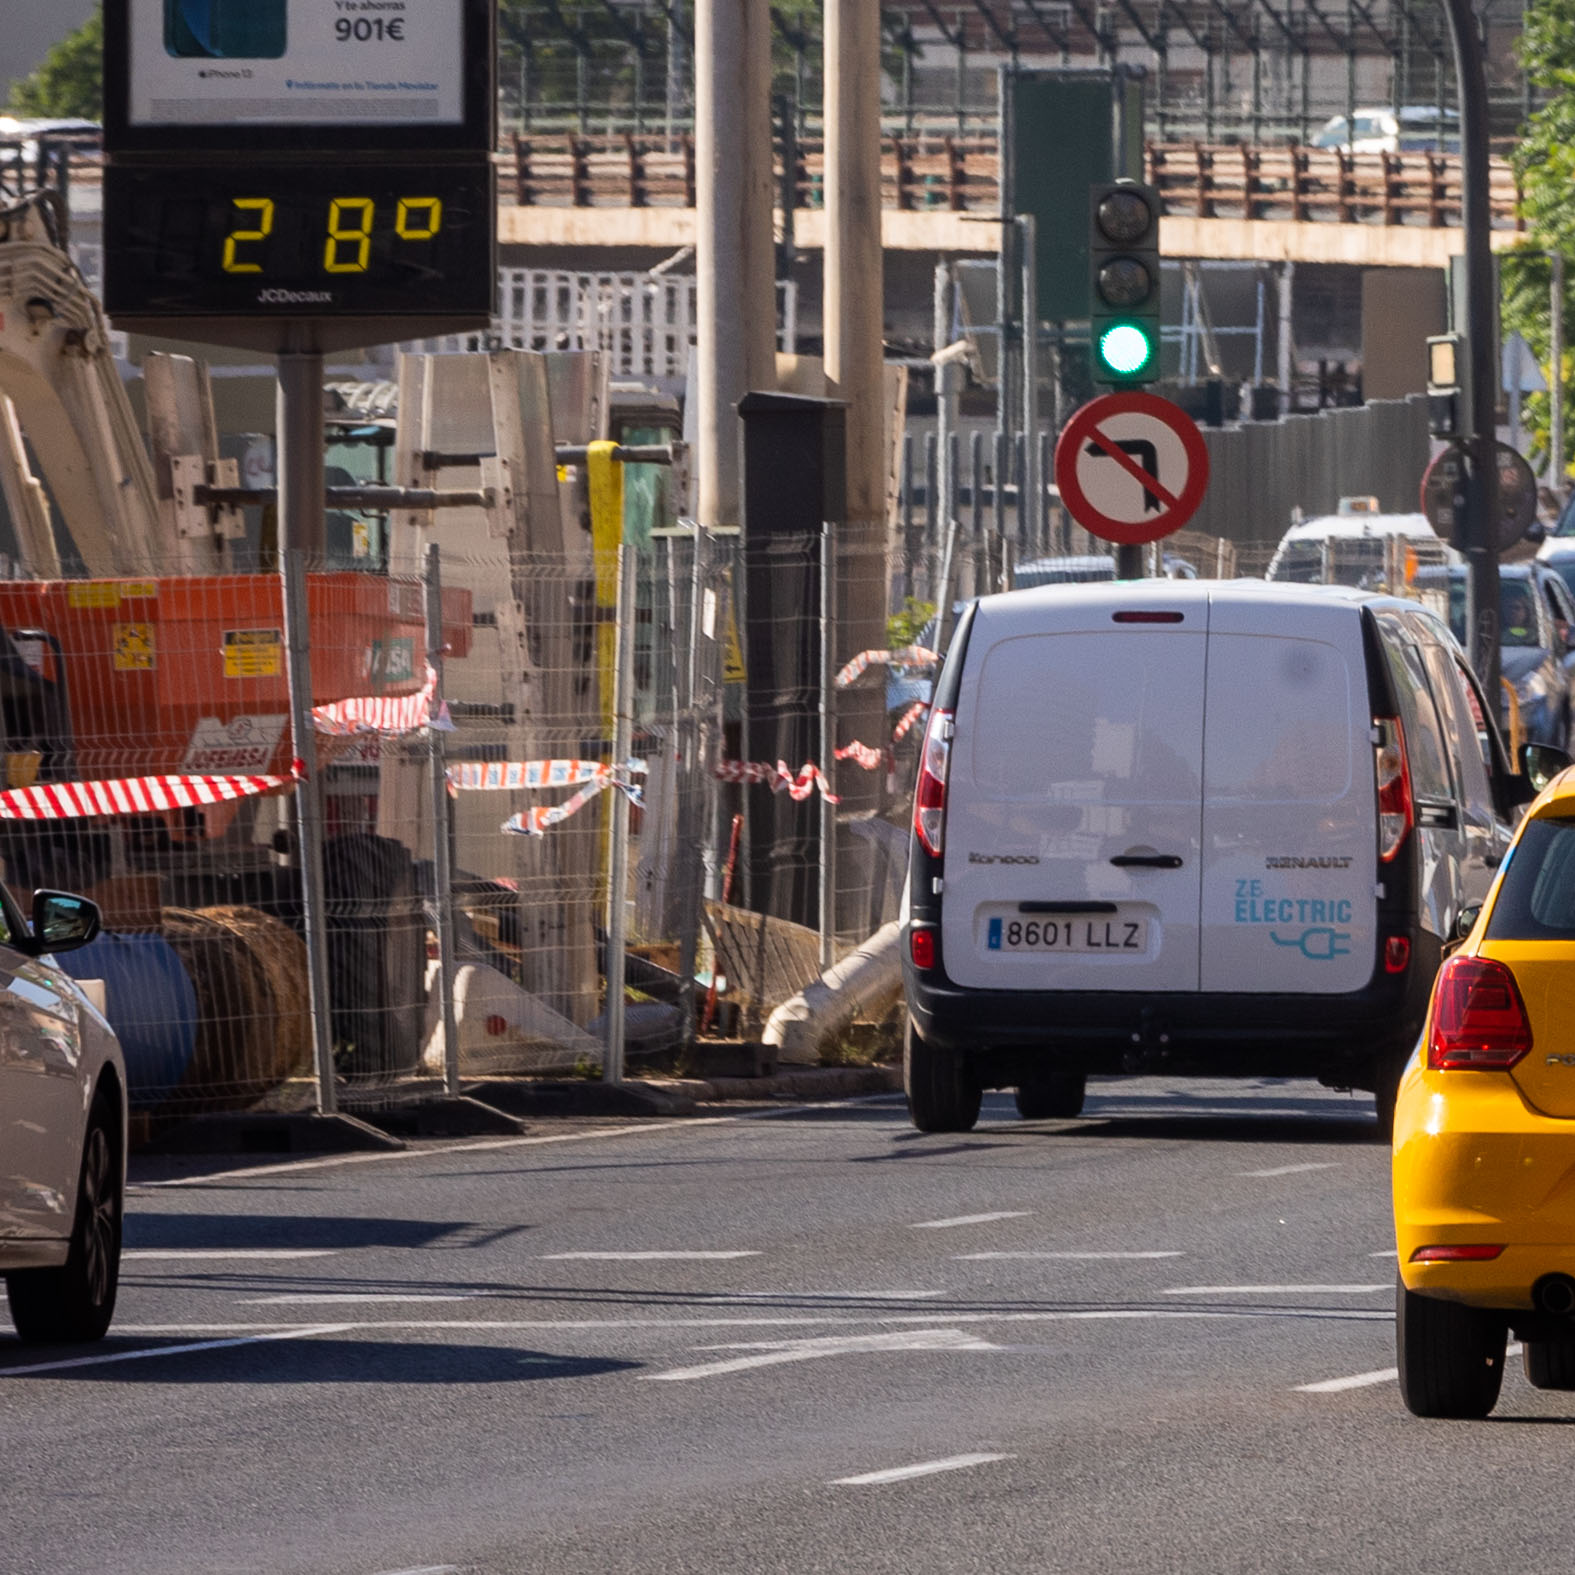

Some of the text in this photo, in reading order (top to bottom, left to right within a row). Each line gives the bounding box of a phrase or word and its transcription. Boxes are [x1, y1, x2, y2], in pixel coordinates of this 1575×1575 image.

[359, 0, 406, 11] ahorras
[335, 17, 405, 42] 901€
[257, 289, 332, 304] JCDecaux
[1265, 855, 1354, 870] RENAULT
[1234, 899, 1353, 924] ELECTRIC
[1007, 922, 1140, 948] 8601 LLZ
